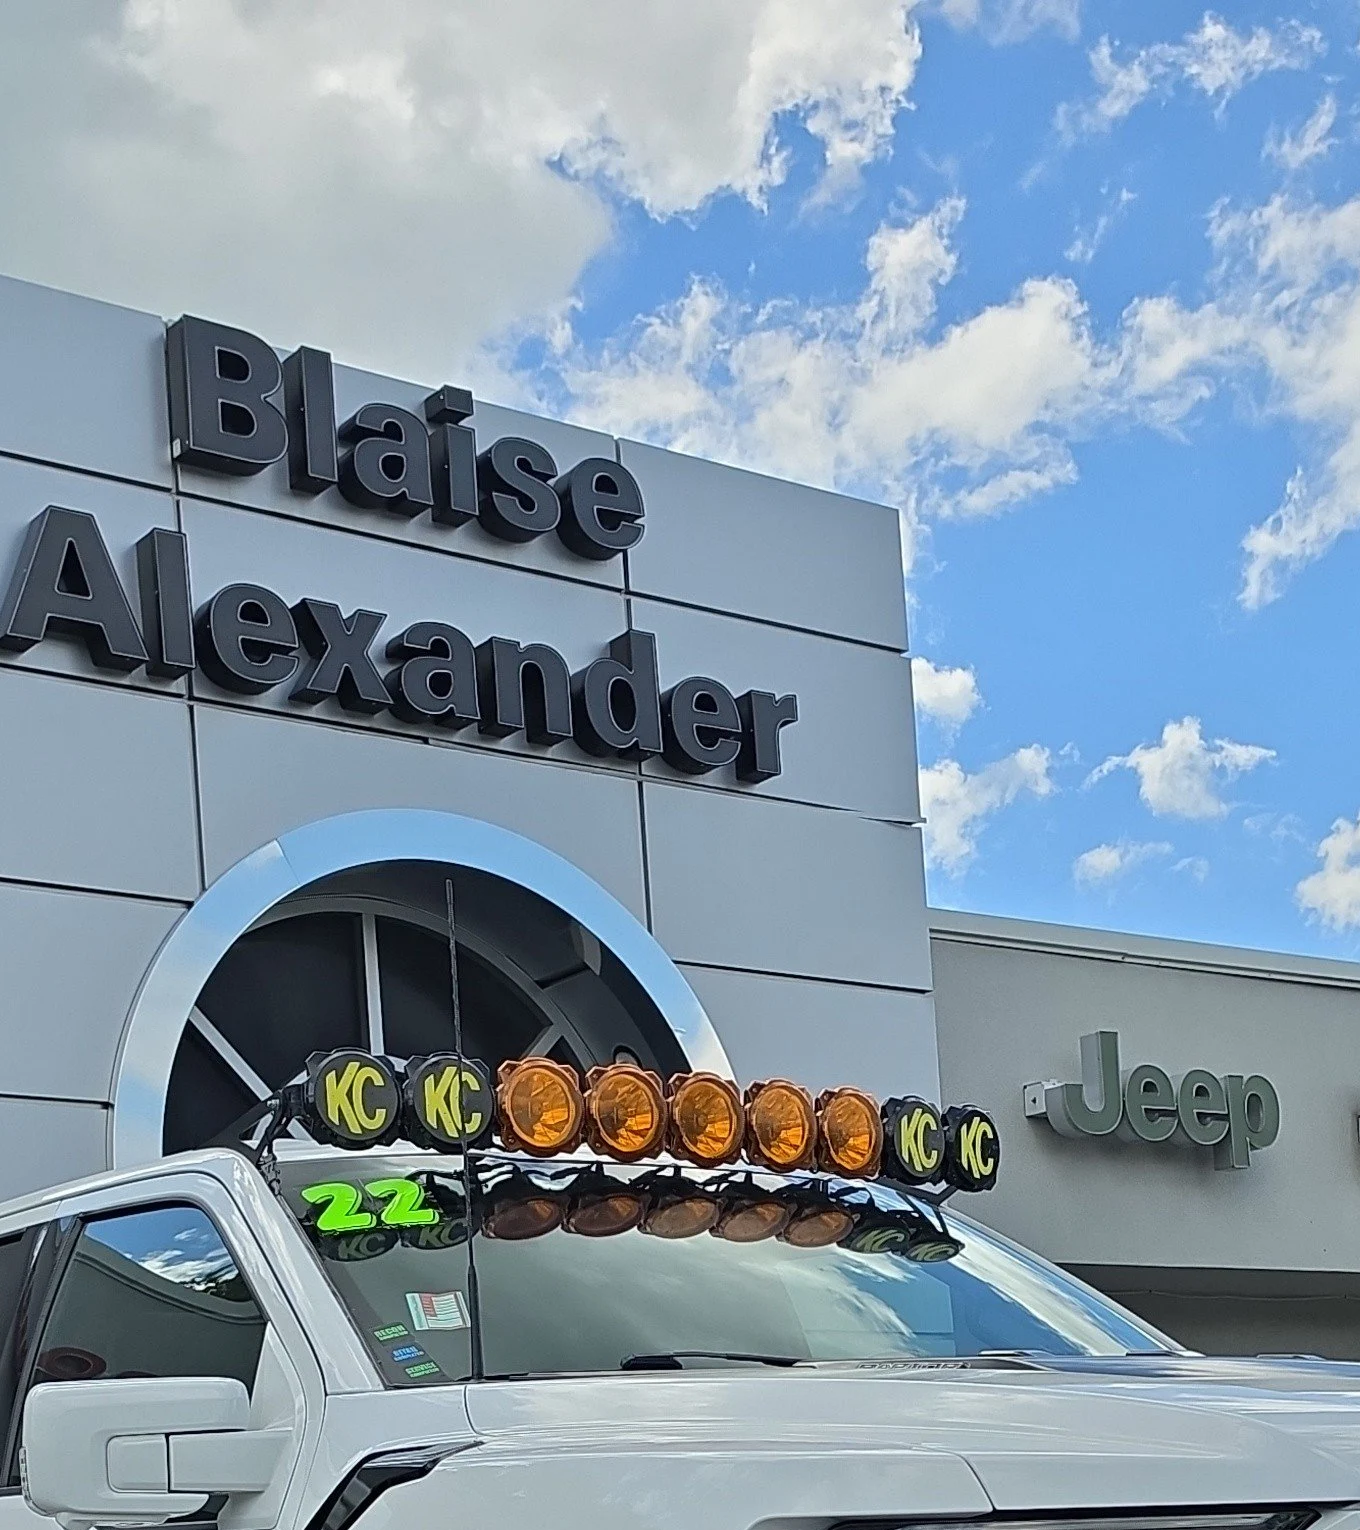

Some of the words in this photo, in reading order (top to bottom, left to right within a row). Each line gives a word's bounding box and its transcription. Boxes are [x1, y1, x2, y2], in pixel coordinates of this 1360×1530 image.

[167, 314, 646, 562] Blaise
[325, 1061, 387, 1134] KC
[424, 1066, 482, 1138] KC
[1044, 1030, 1281, 1171] Jeep
[900, 1107, 938, 1172] KC
[960, 1116, 994, 1180] KC
[301, 1178, 439, 1232] 22
